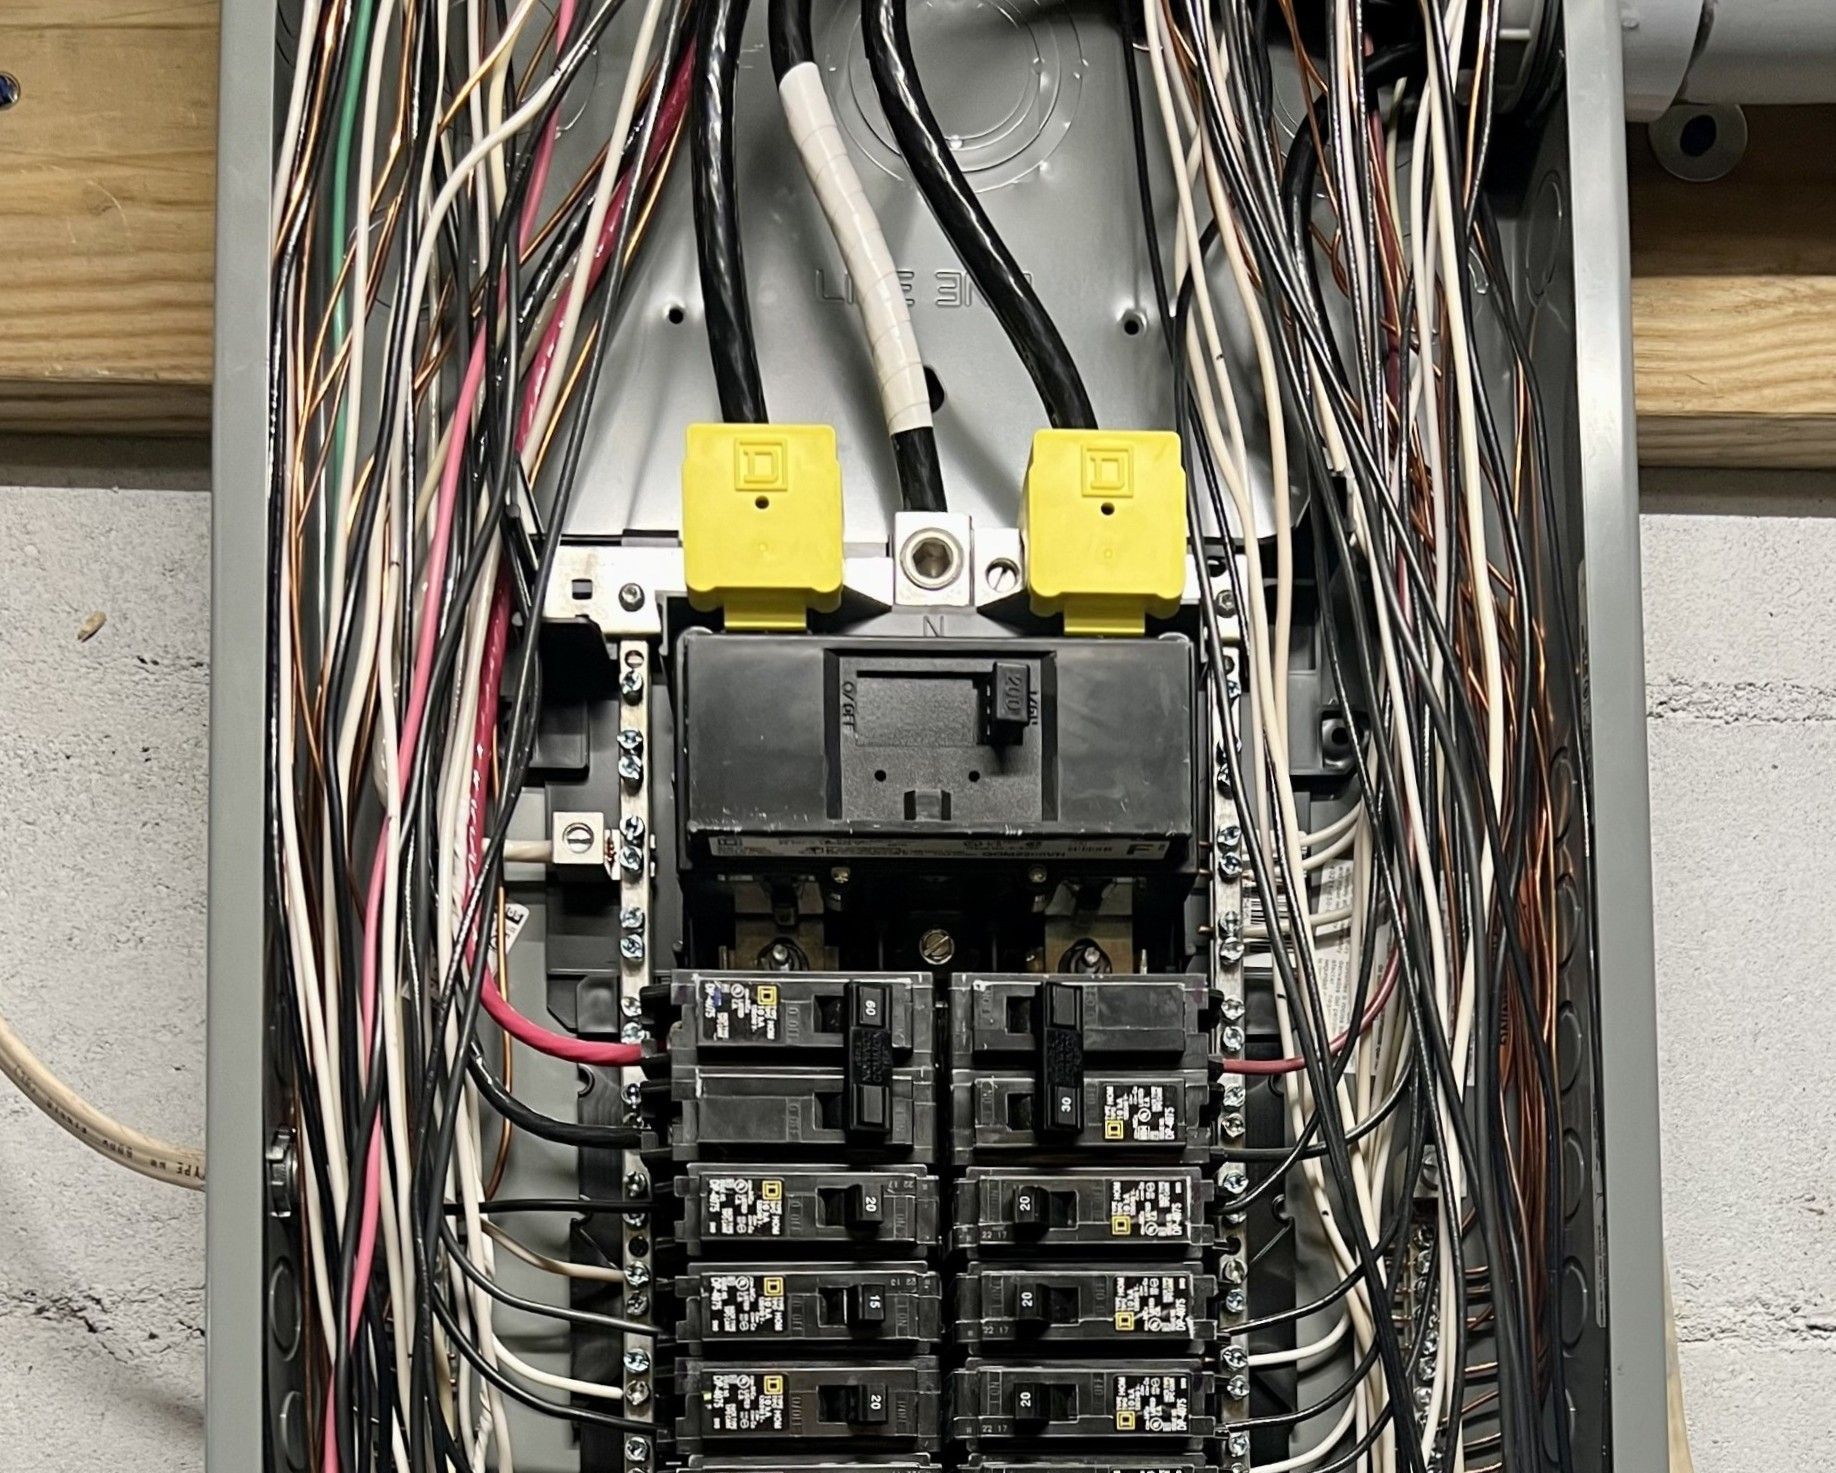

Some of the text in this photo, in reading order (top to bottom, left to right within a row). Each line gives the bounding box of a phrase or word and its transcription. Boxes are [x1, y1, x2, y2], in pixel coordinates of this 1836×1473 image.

[815, 269, 915, 305] LIE
[923, 617, 943, 637] N
[865, 1000, 876, 1016] 60
[1061, 1097, 1072, 1112] 30
[865, 1196, 877, 1212] 20
[1019, 1196, 1031, 1211] 20
[869, 1295, 881, 1309] 15
[1021, 1292, 1033, 1307] 20
[870, 1394, 882, 1410] 20
[1020, 1391, 1031, 1407] 20
